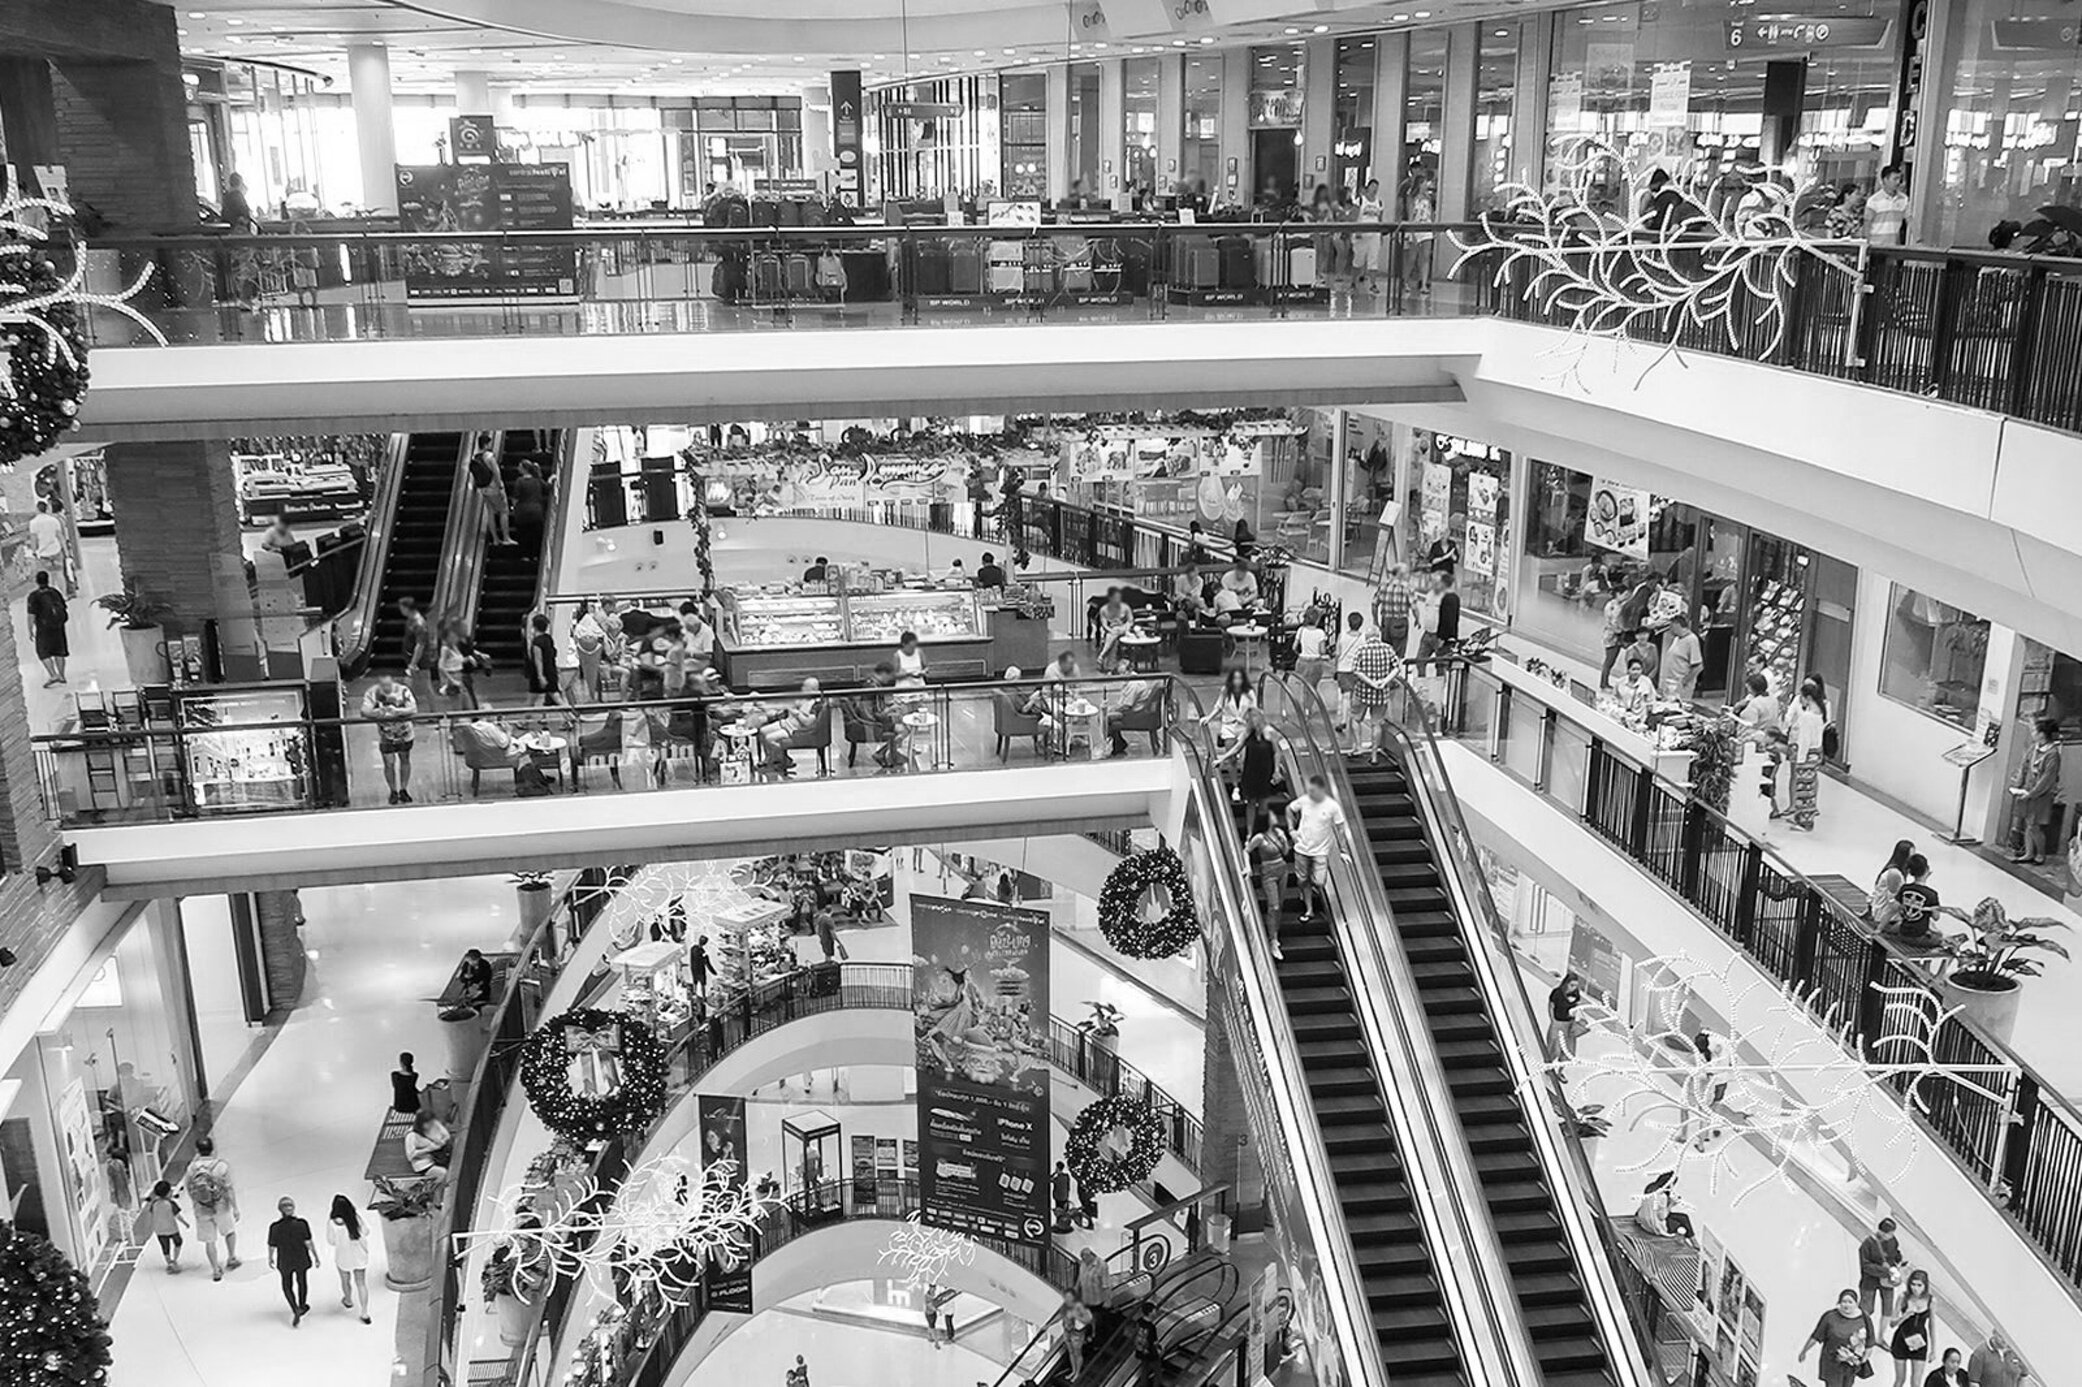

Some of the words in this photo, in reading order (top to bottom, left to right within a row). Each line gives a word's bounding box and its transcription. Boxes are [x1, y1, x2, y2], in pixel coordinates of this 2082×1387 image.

[1731, 29, 1742, 46] 6
[1217, 293, 1243, 301] WORLD
[806, 452, 860, 484] San
[997, 1117, 1025, 1130] iPhone
[1026, 1121, 1033, 1131] X
[1149, 1251, 1158, 1268] 3
[719, 1285, 748, 1297] FLOOR
